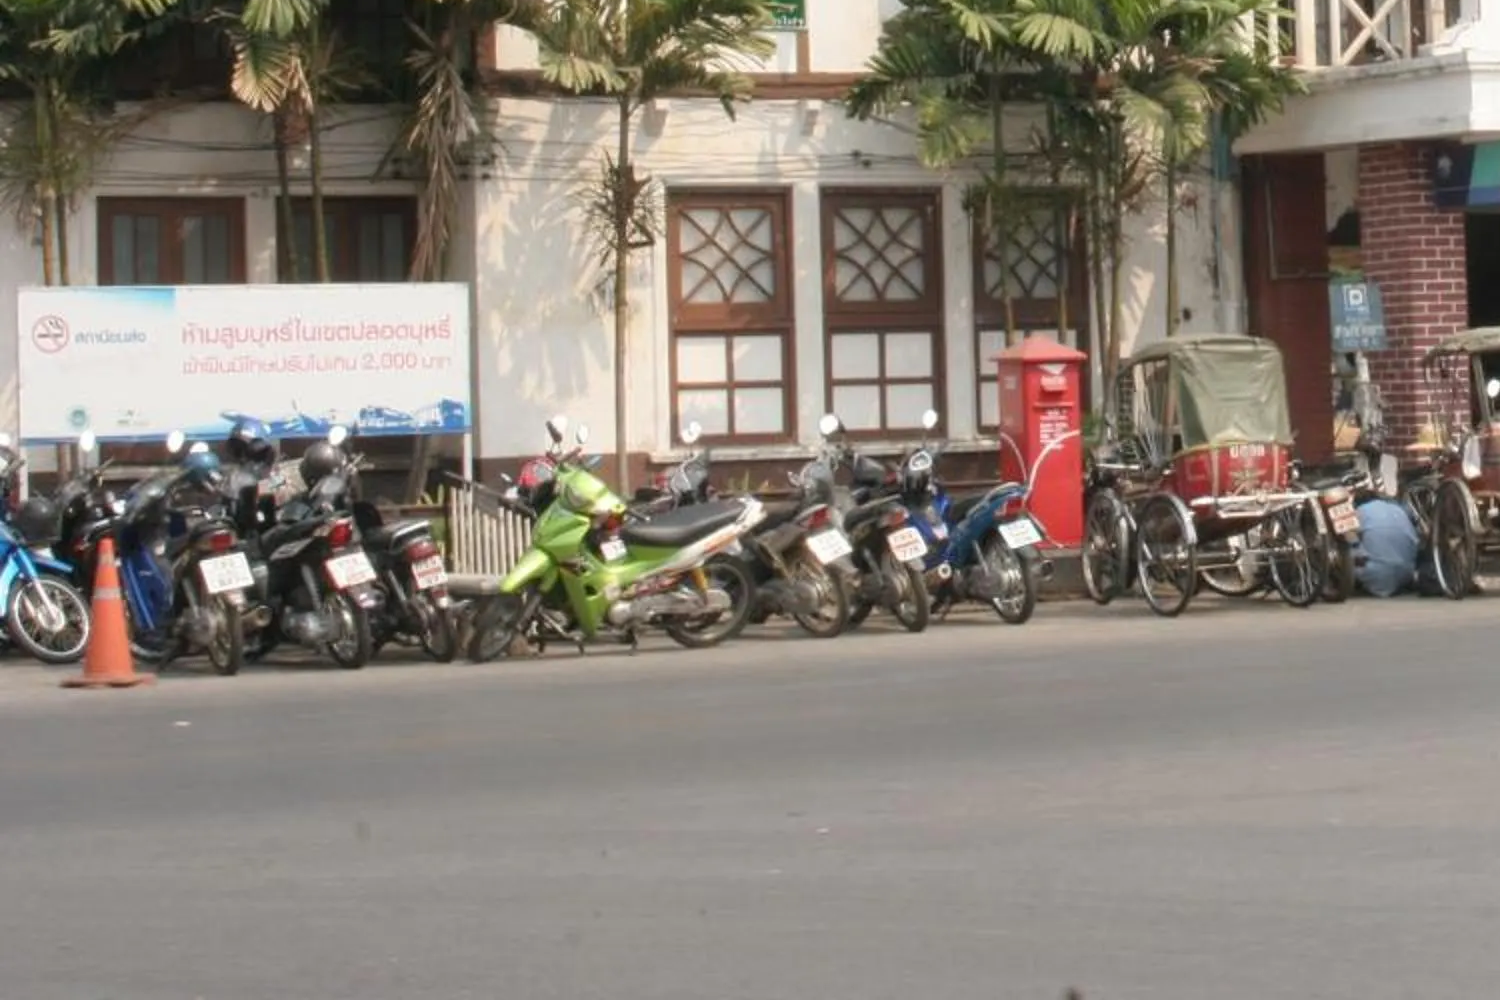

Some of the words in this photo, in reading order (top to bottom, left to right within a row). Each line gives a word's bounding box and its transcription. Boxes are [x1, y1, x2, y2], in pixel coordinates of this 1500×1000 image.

[182, 316, 452, 348] ห้ามสูบบุหรี่ในเขตปลอดบุหรี่
[362, 352, 418, 371] 2,000
